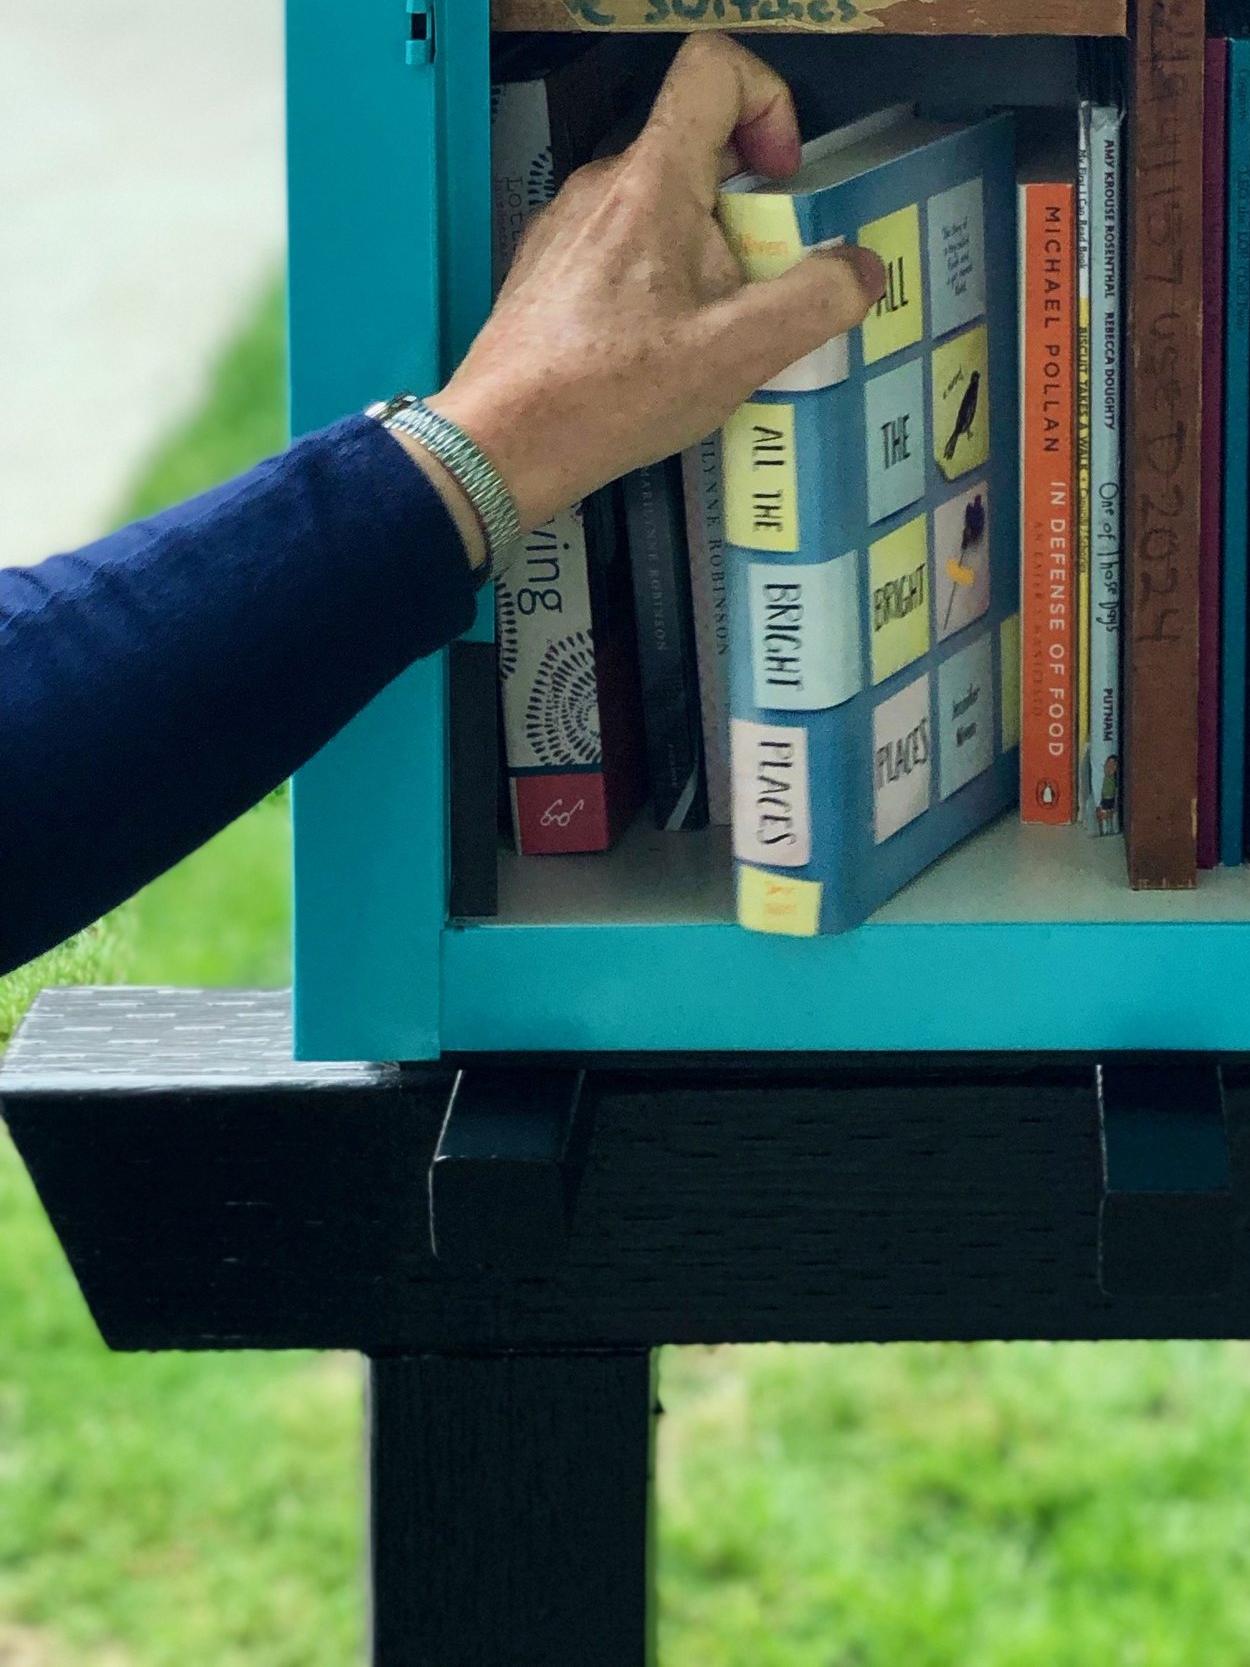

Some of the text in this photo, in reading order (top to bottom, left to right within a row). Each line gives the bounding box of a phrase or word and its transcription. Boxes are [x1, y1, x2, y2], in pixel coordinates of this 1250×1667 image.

[1104, 139, 1116, 430] AMY KROUSE ROSENTHAL REBECCA DOUGHTY
[752, 426, 787, 533] ALL THE
[880, 414, 911, 469] THE
[1043, 206, 1065, 757] MICHAEL POLLAN IN DEFENSE OF FOOD
[763, 583, 803, 691] BRIGHT
[874, 564, 925, 632] BRIGHT
[875, 718, 928, 791] PLACES
[1103, 688, 1114, 741] PUTNAM
[756, 740, 796, 847] PLACES
